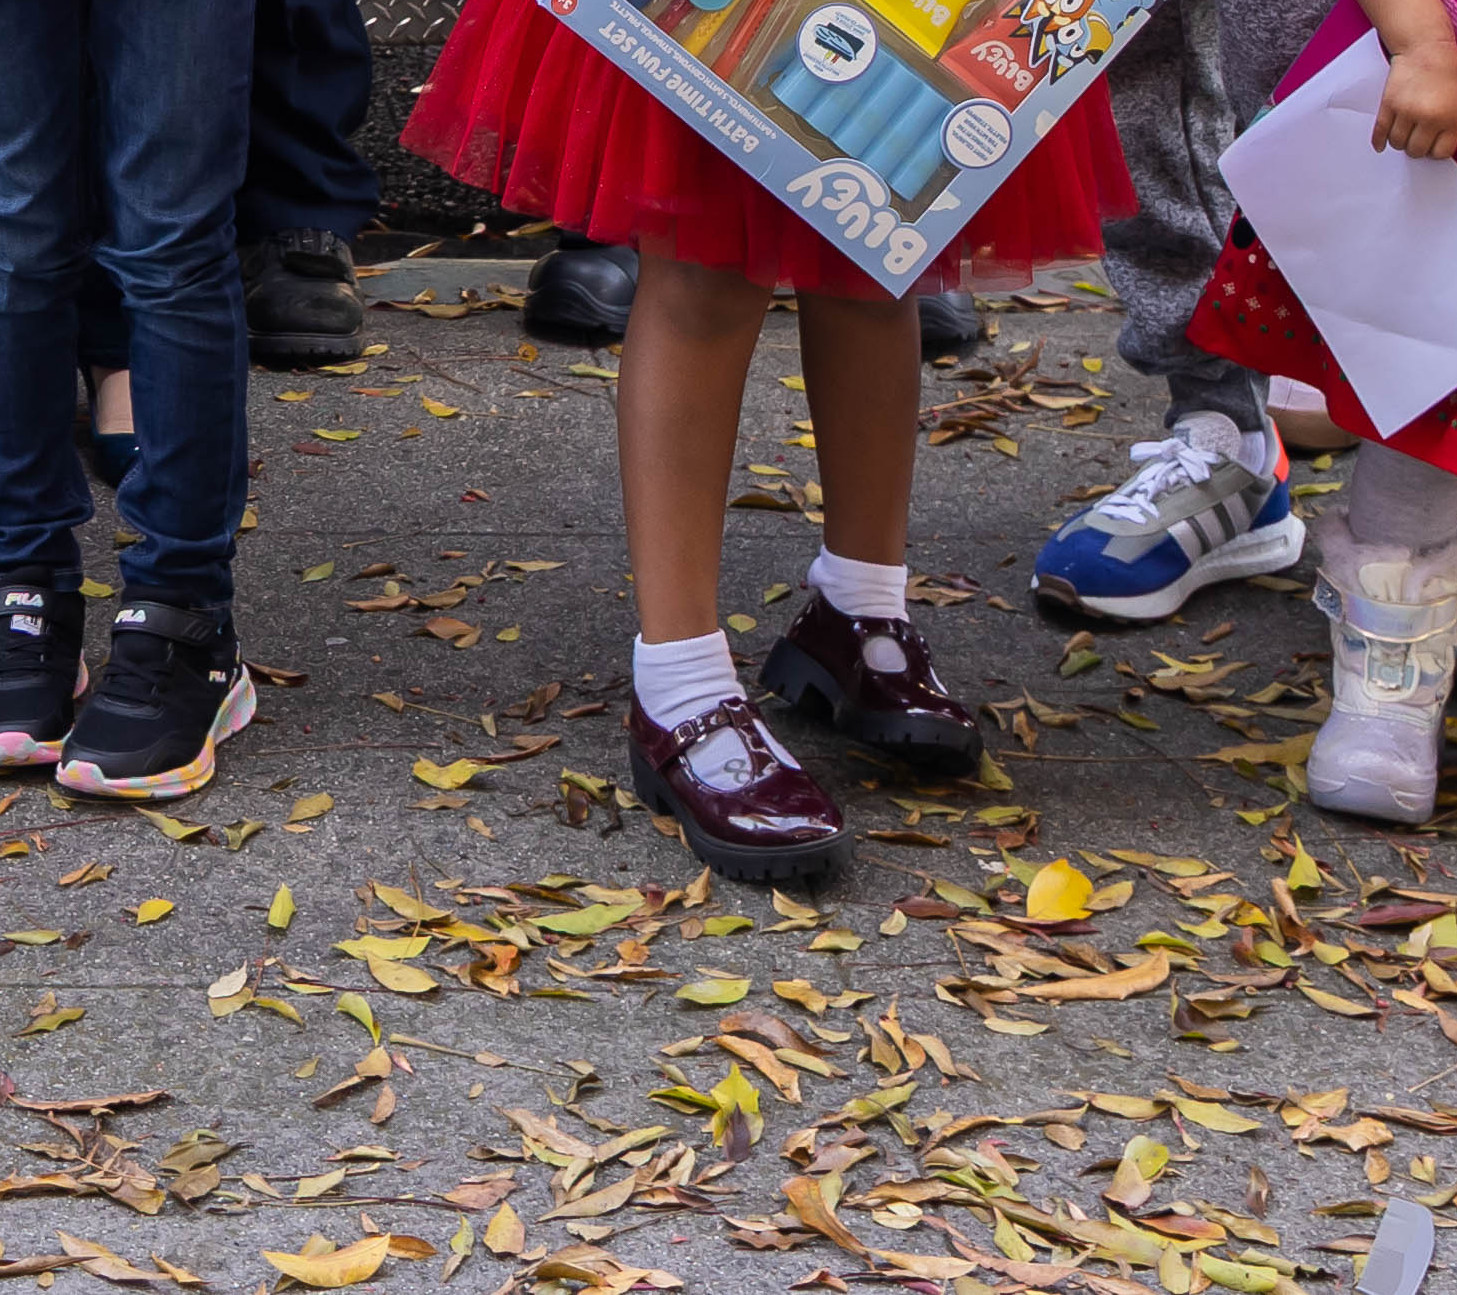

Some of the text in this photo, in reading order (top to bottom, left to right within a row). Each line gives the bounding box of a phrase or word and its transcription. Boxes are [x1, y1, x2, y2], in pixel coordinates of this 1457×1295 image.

[629, 41, 674, 84] FUN
[969, 40, 1034, 91] BLUEY
[784, 163, 927, 275] BLUEY
[4, 592, 44, 607] FILA
[114, 609, 147, 624] FILA
[209, 670, 227, 682] FILA
